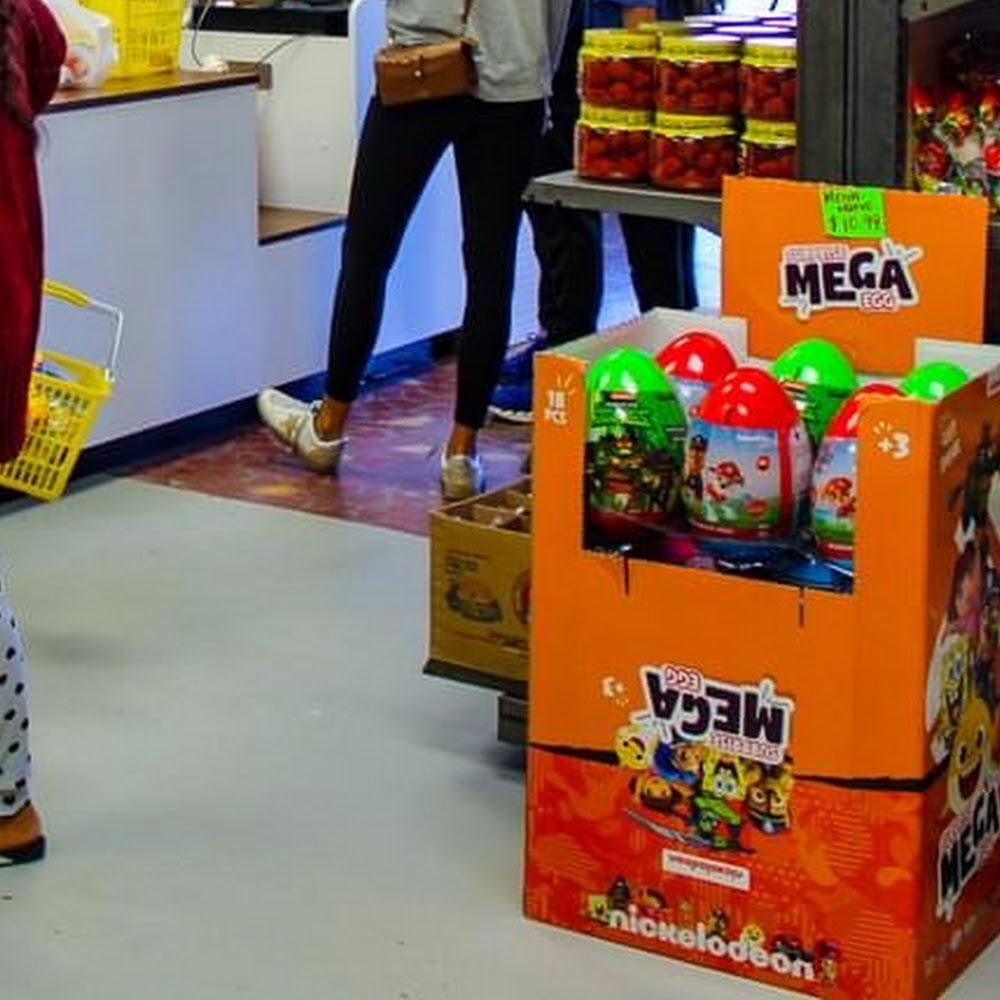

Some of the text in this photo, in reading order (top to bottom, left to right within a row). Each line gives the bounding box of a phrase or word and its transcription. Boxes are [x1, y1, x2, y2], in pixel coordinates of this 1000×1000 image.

[785, 251, 914, 305] MEGA
[862, 291, 896, 311] EGG
[664, 665, 700, 689] EGG
[645, 671, 785, 745] MEGA
[607, 904, 817, 981] nickelodeon
